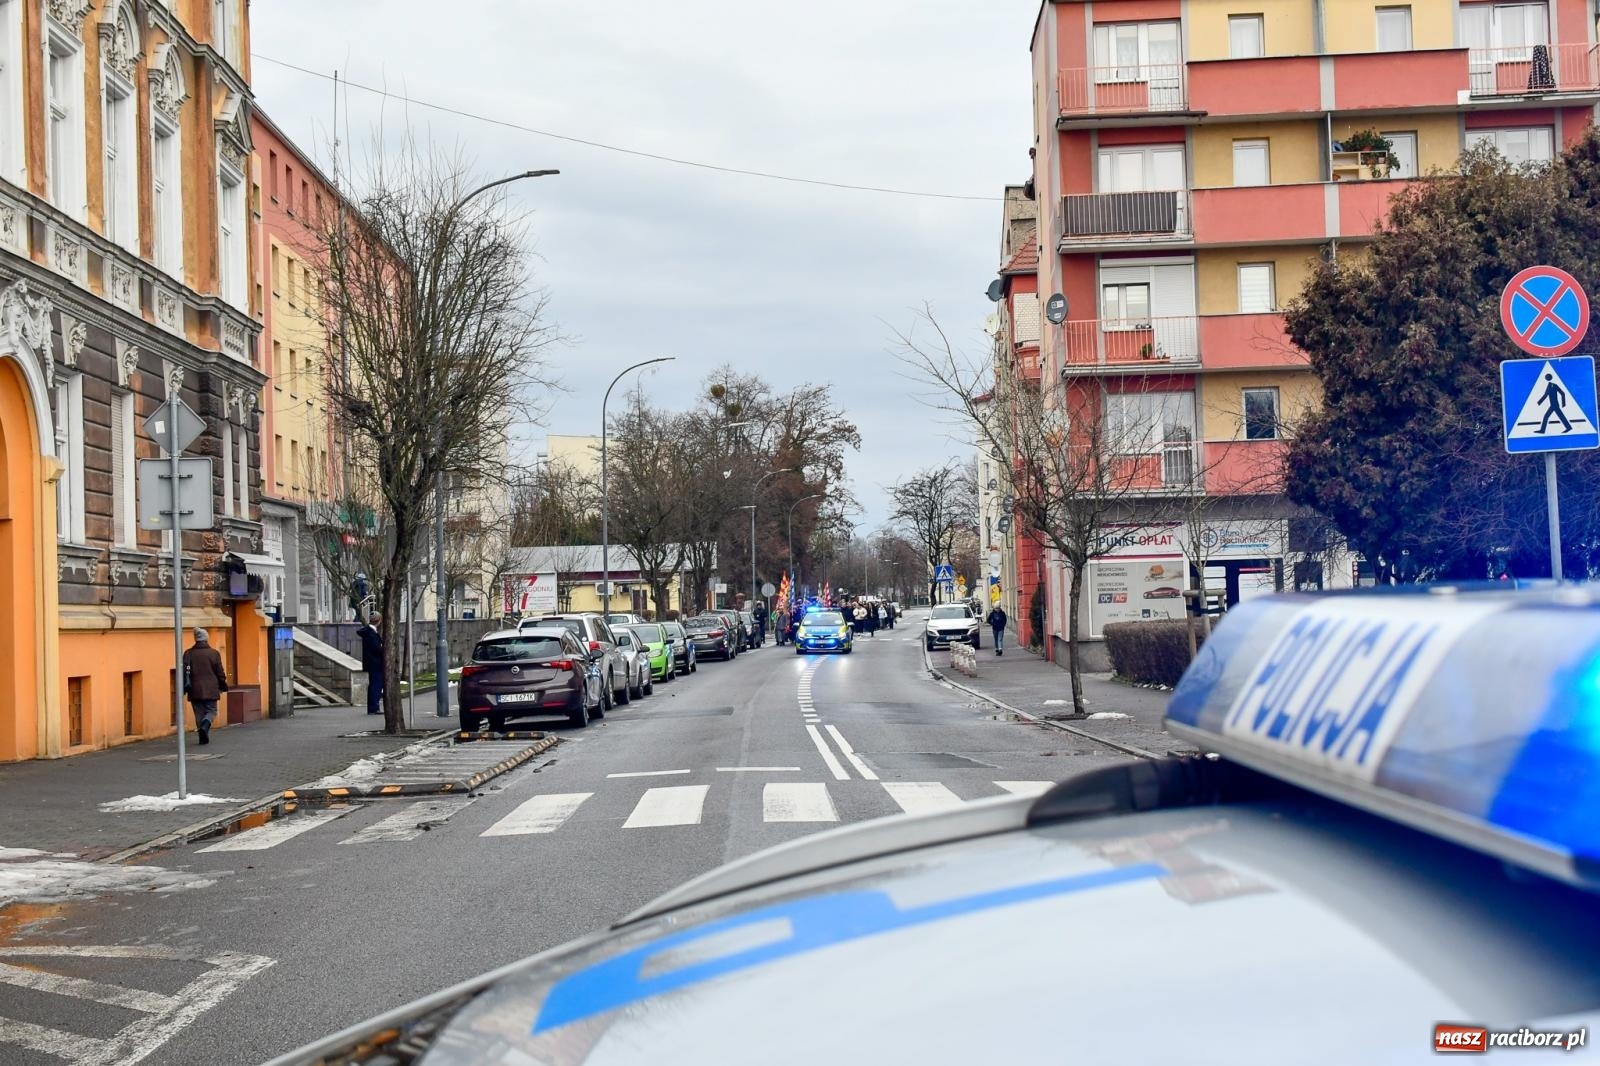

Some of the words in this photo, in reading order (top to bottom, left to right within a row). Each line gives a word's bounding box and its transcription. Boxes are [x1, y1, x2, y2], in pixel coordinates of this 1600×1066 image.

[1099, 535, 1135, 547] PUNKT
[1100, 594, 1111, 602] OC
[1232, 613, 1439, 766] POLICJA
